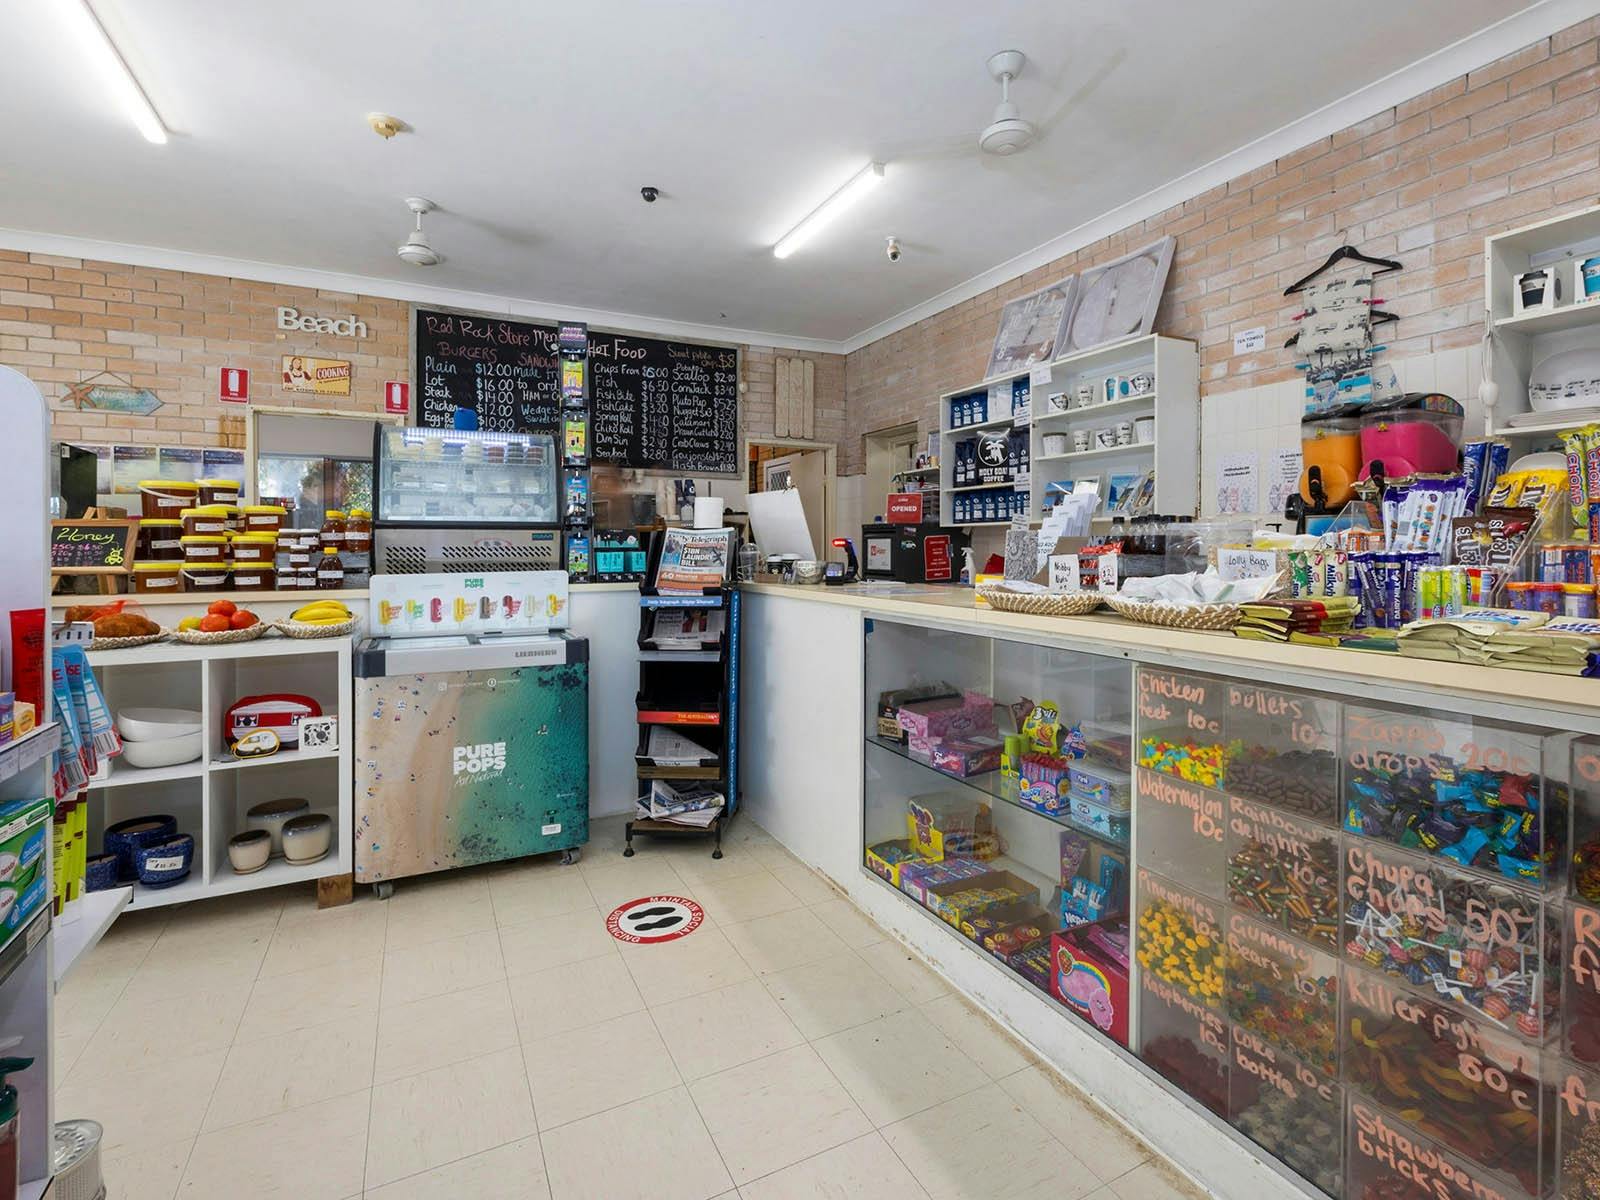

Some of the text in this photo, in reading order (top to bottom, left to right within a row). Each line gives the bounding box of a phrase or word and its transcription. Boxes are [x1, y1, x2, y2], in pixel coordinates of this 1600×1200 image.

[277, 306, 368, 338] Beach
[460, 320, 497, 344] Rock
[498, 323, 530, 346] Store
[533, 329, 558, 352] Men
[437, 342, 497, 364] BURGERS
[614, 339, 647, 360] FOOD
[317, 366, 349, 379] COOKING
[425, 355, 457, 374] Plain
[594, 362, 618, 378] Chips
[673, 368, 710, 386] Scallop
[425, 386, 452, 398] Steak
[426, 373, 445, 386] Lot
[516, 379, 528, 390] to
[595, 375, 618, 388] Fish
[424, 399, 457, 412] Chicken
[523, 390, 540, 401] HAM
[521, 404, 559, 419] Wedges
[1567, 453, 1585, 506] CHOMP
[56, 527, 115, 545] Honey
[1228, 555, 1247, 568] Lolly
[1139, 672, 1205, 704] Chicken
[1230, 688, 1303, 720] bullets
[1187, 709, 1221, 733] 10c
[1348, 715, 1446, 750] Zappo
[453, 742, 506, 760] PURE
[1349, 746, 1441, 780] drops
[1460, 743, 1532, 777] 20c
[453, 756, 506, 775] POPS
[1137, 770, 1223, 819] Watermelon
[1193, 813, 1223, 842] 10c
[1230, 797, 1326, 841] Rainbow
[1231, 818, 1313, 861] delights
[1348, 848, 1435, 898] Chupa
[1347, 875, 1448, 932] Chups
[608, 896, 701, 942] MAINTAIN SOCIAL DISTANCING
[1193, 916, 1221, 944] 10c
[1230, 915, 1313, 976] Gummy
[1294, 973, 1327, 1001] 10c
[1347, 971, 1427, 1024] Killer
[1458, 1052, 1533, 1111] 60c
